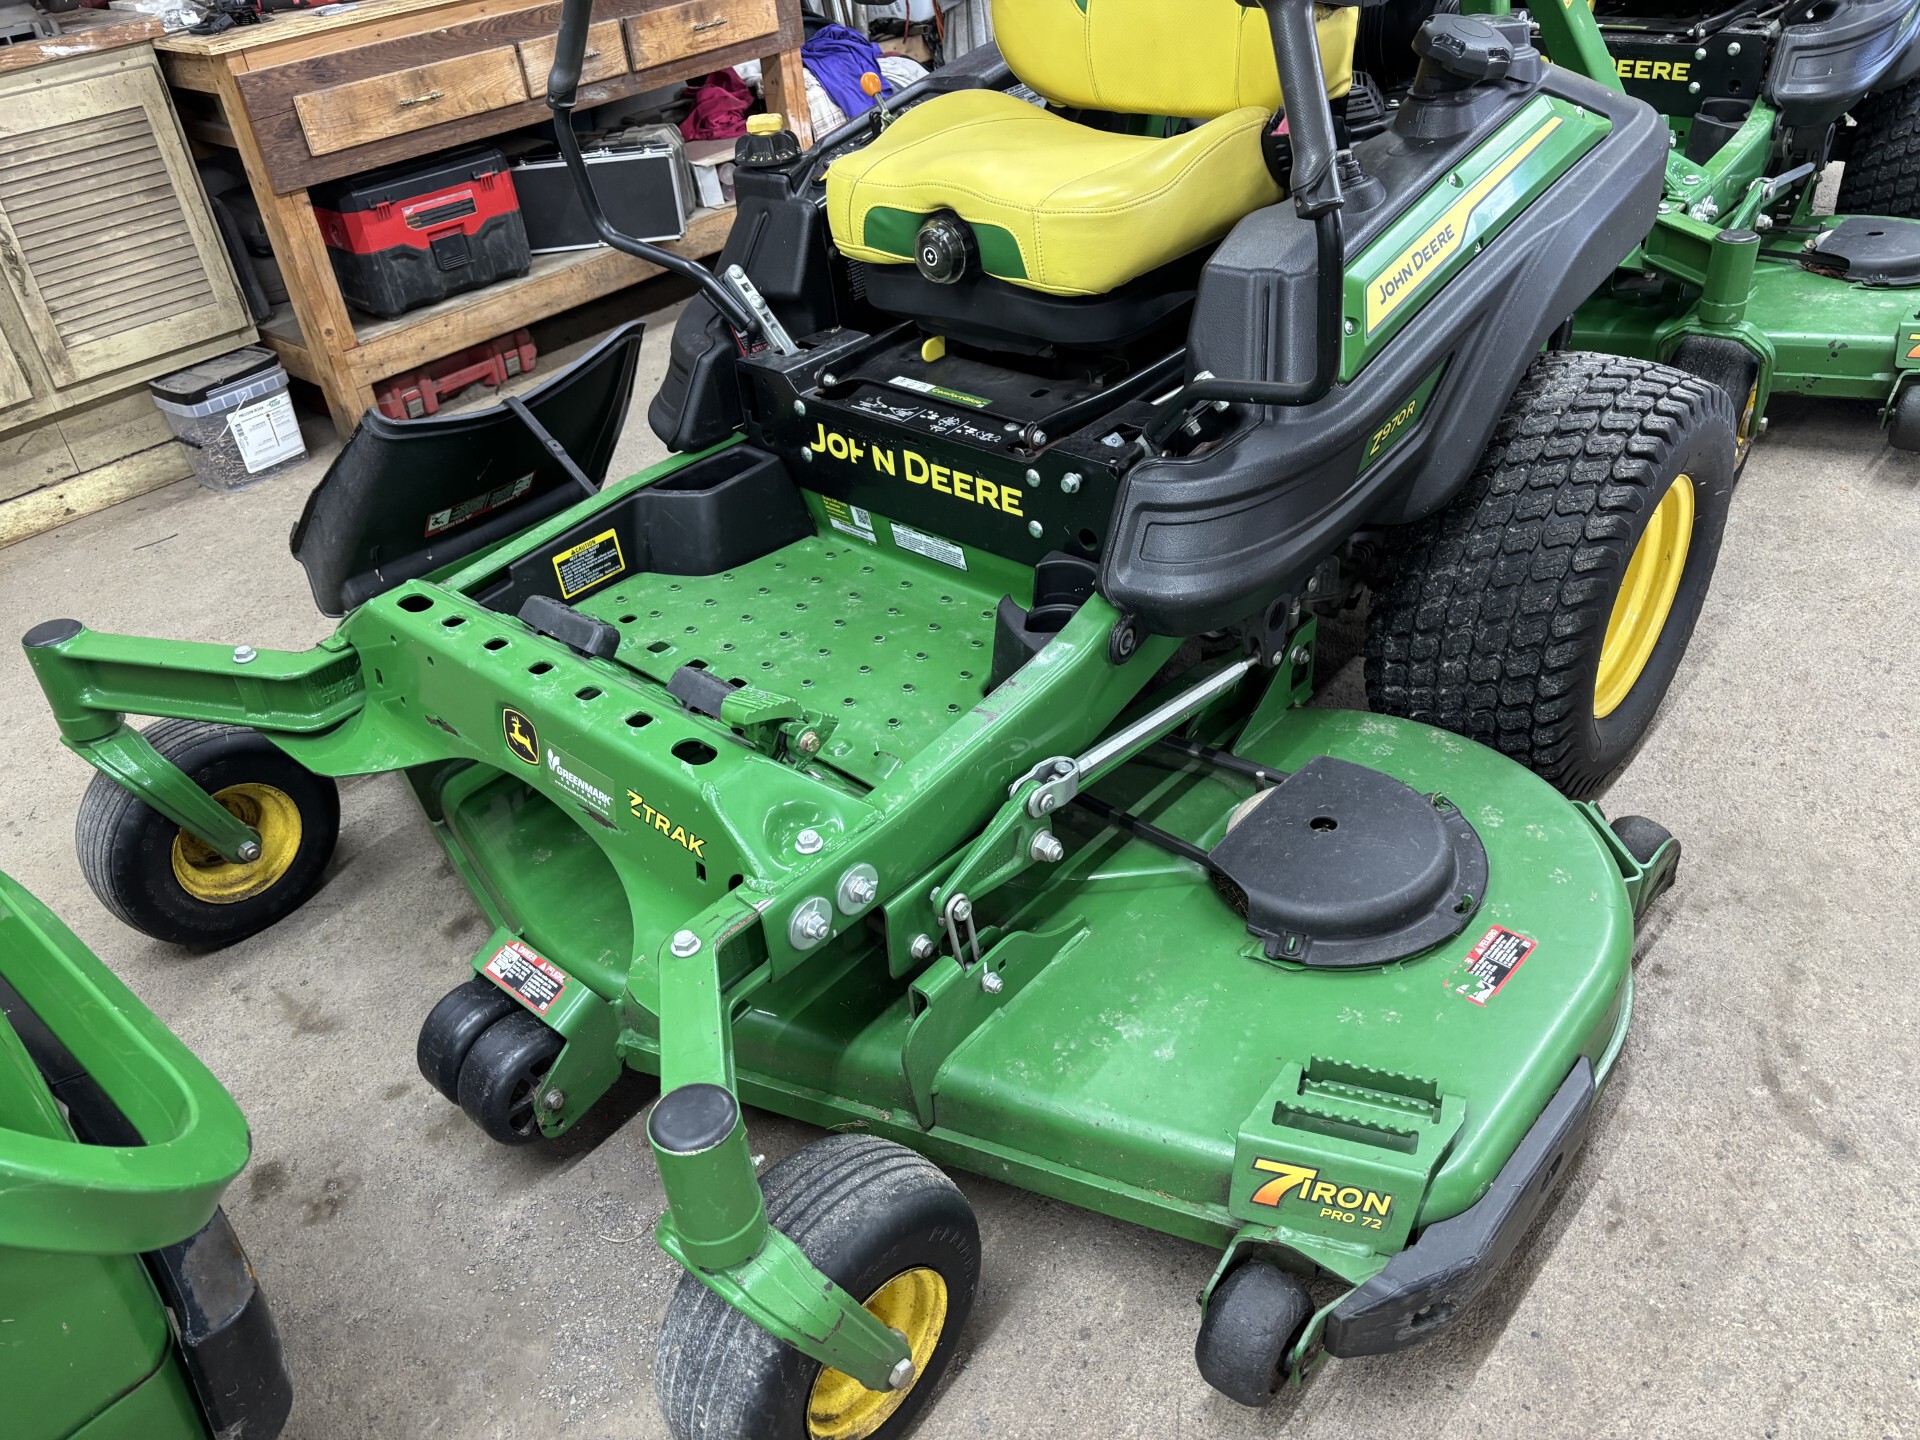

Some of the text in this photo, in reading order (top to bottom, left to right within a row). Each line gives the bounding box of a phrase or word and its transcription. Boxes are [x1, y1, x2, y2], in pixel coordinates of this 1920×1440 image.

[1610, 56, 1691, 81] EERE
[1380, 223, 1455, 305] JOHN DEERE
[1369, 400, 1416, 456] Z970R
[903, 449, 1024, 517] DEERE
[575, 539, 596, 553] CAUTION
[556, 765, 611, 806] GREENMARK
[518, 945, 538, 963] DANGER
[1319, 1207, 1383, 1230] PRO 72
